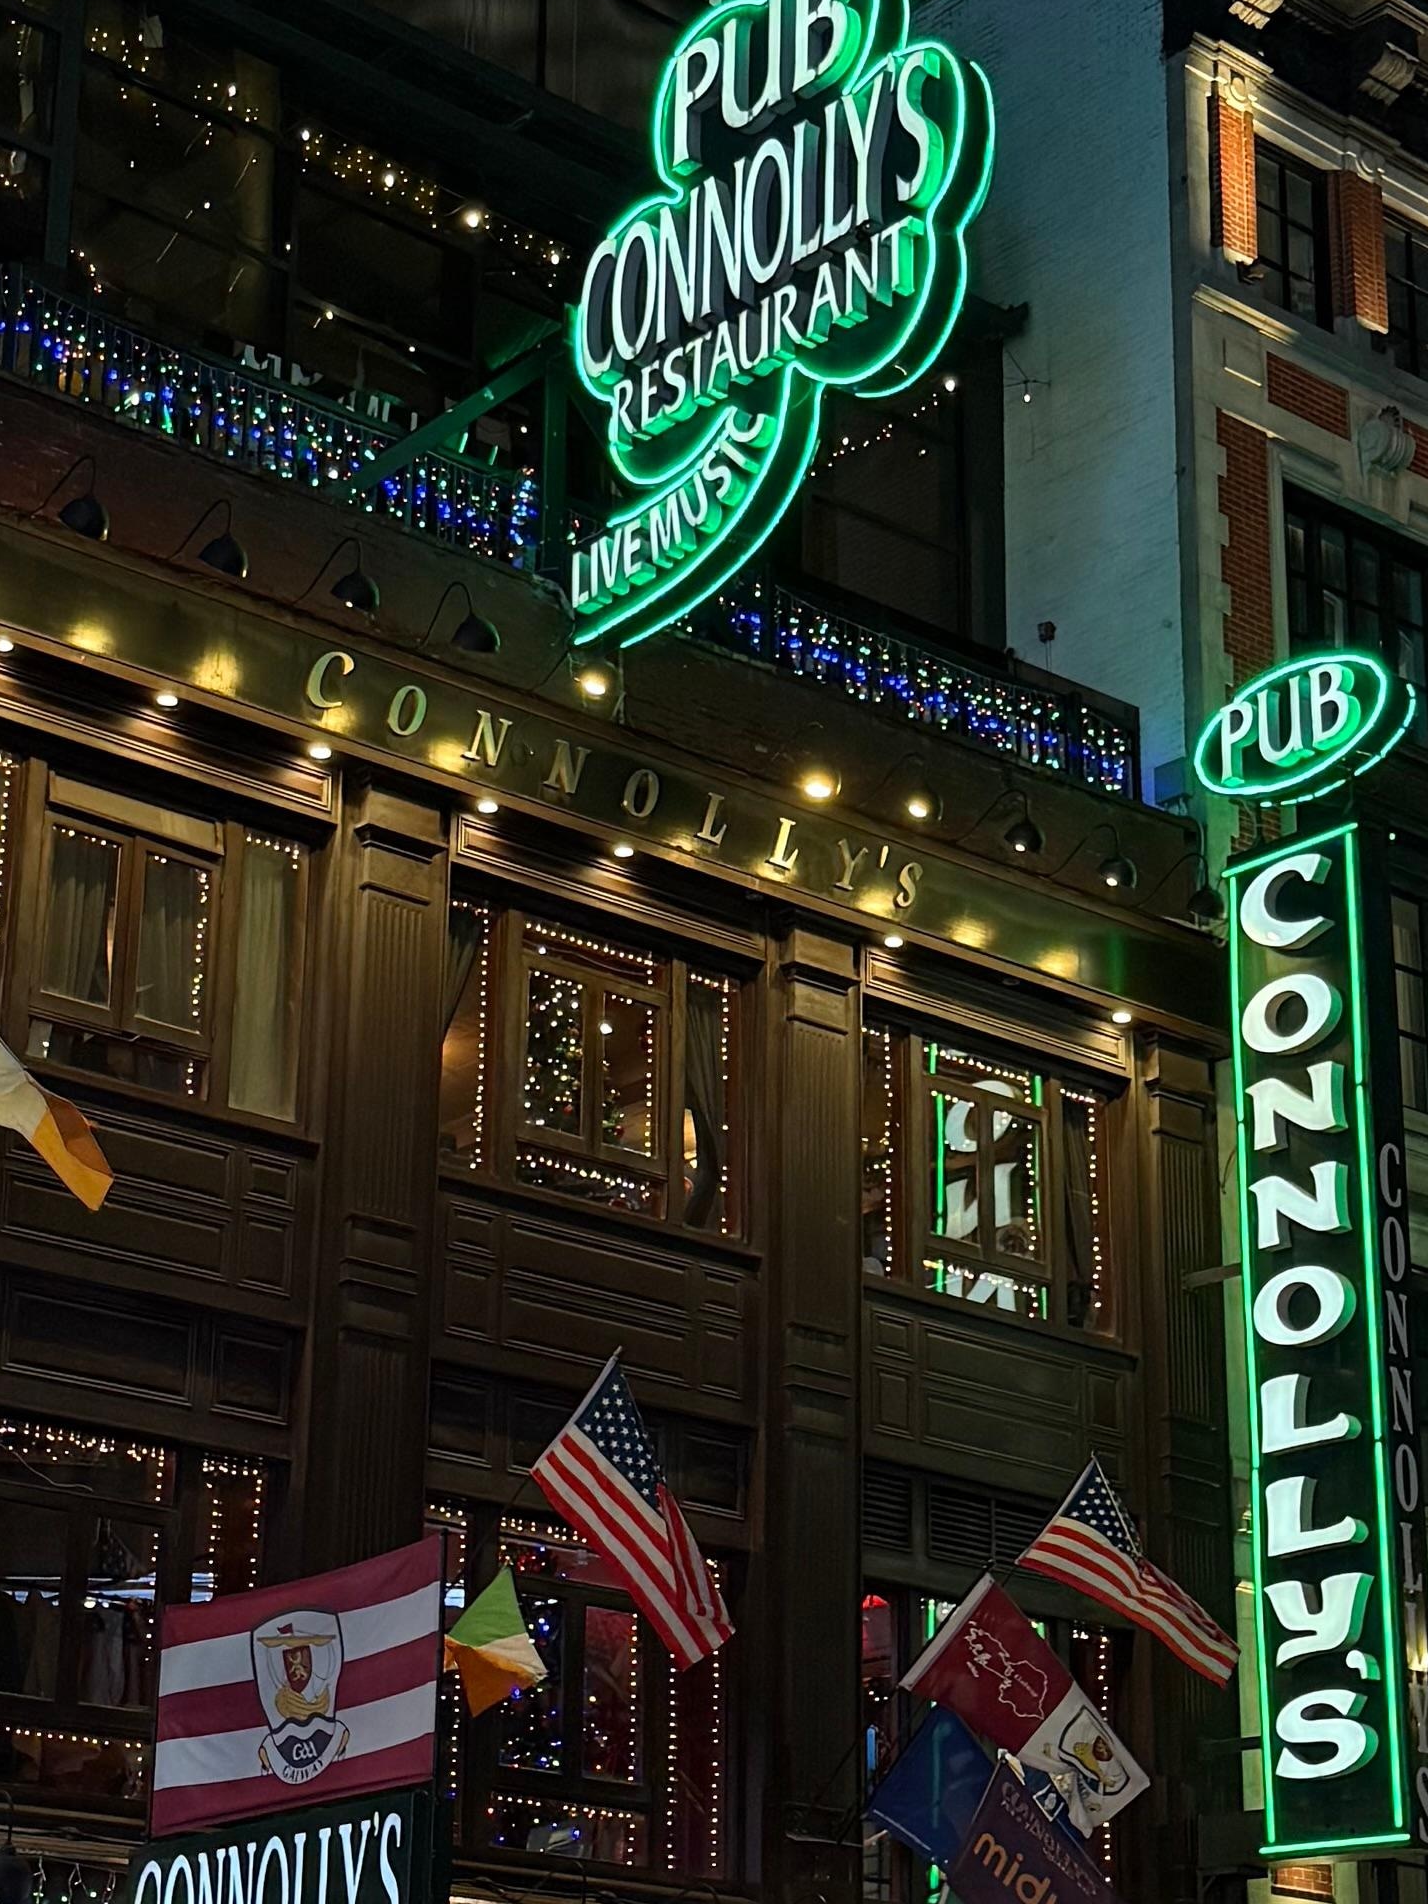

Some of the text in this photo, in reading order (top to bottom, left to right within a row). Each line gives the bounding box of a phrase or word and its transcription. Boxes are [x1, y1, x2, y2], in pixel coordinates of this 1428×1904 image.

[582, 51, 938, 378] CONNOLLY'S
[611, 218, 920, 443] RESTAURANT
[572, 411, 768, 609] LIVE MUSIC
[306, 650, 924, 909] CONNOLLY'S
[1221, 663, 1352, 785] PUB
[1240, 853, 1375, 1780] CONNOLLY'S
